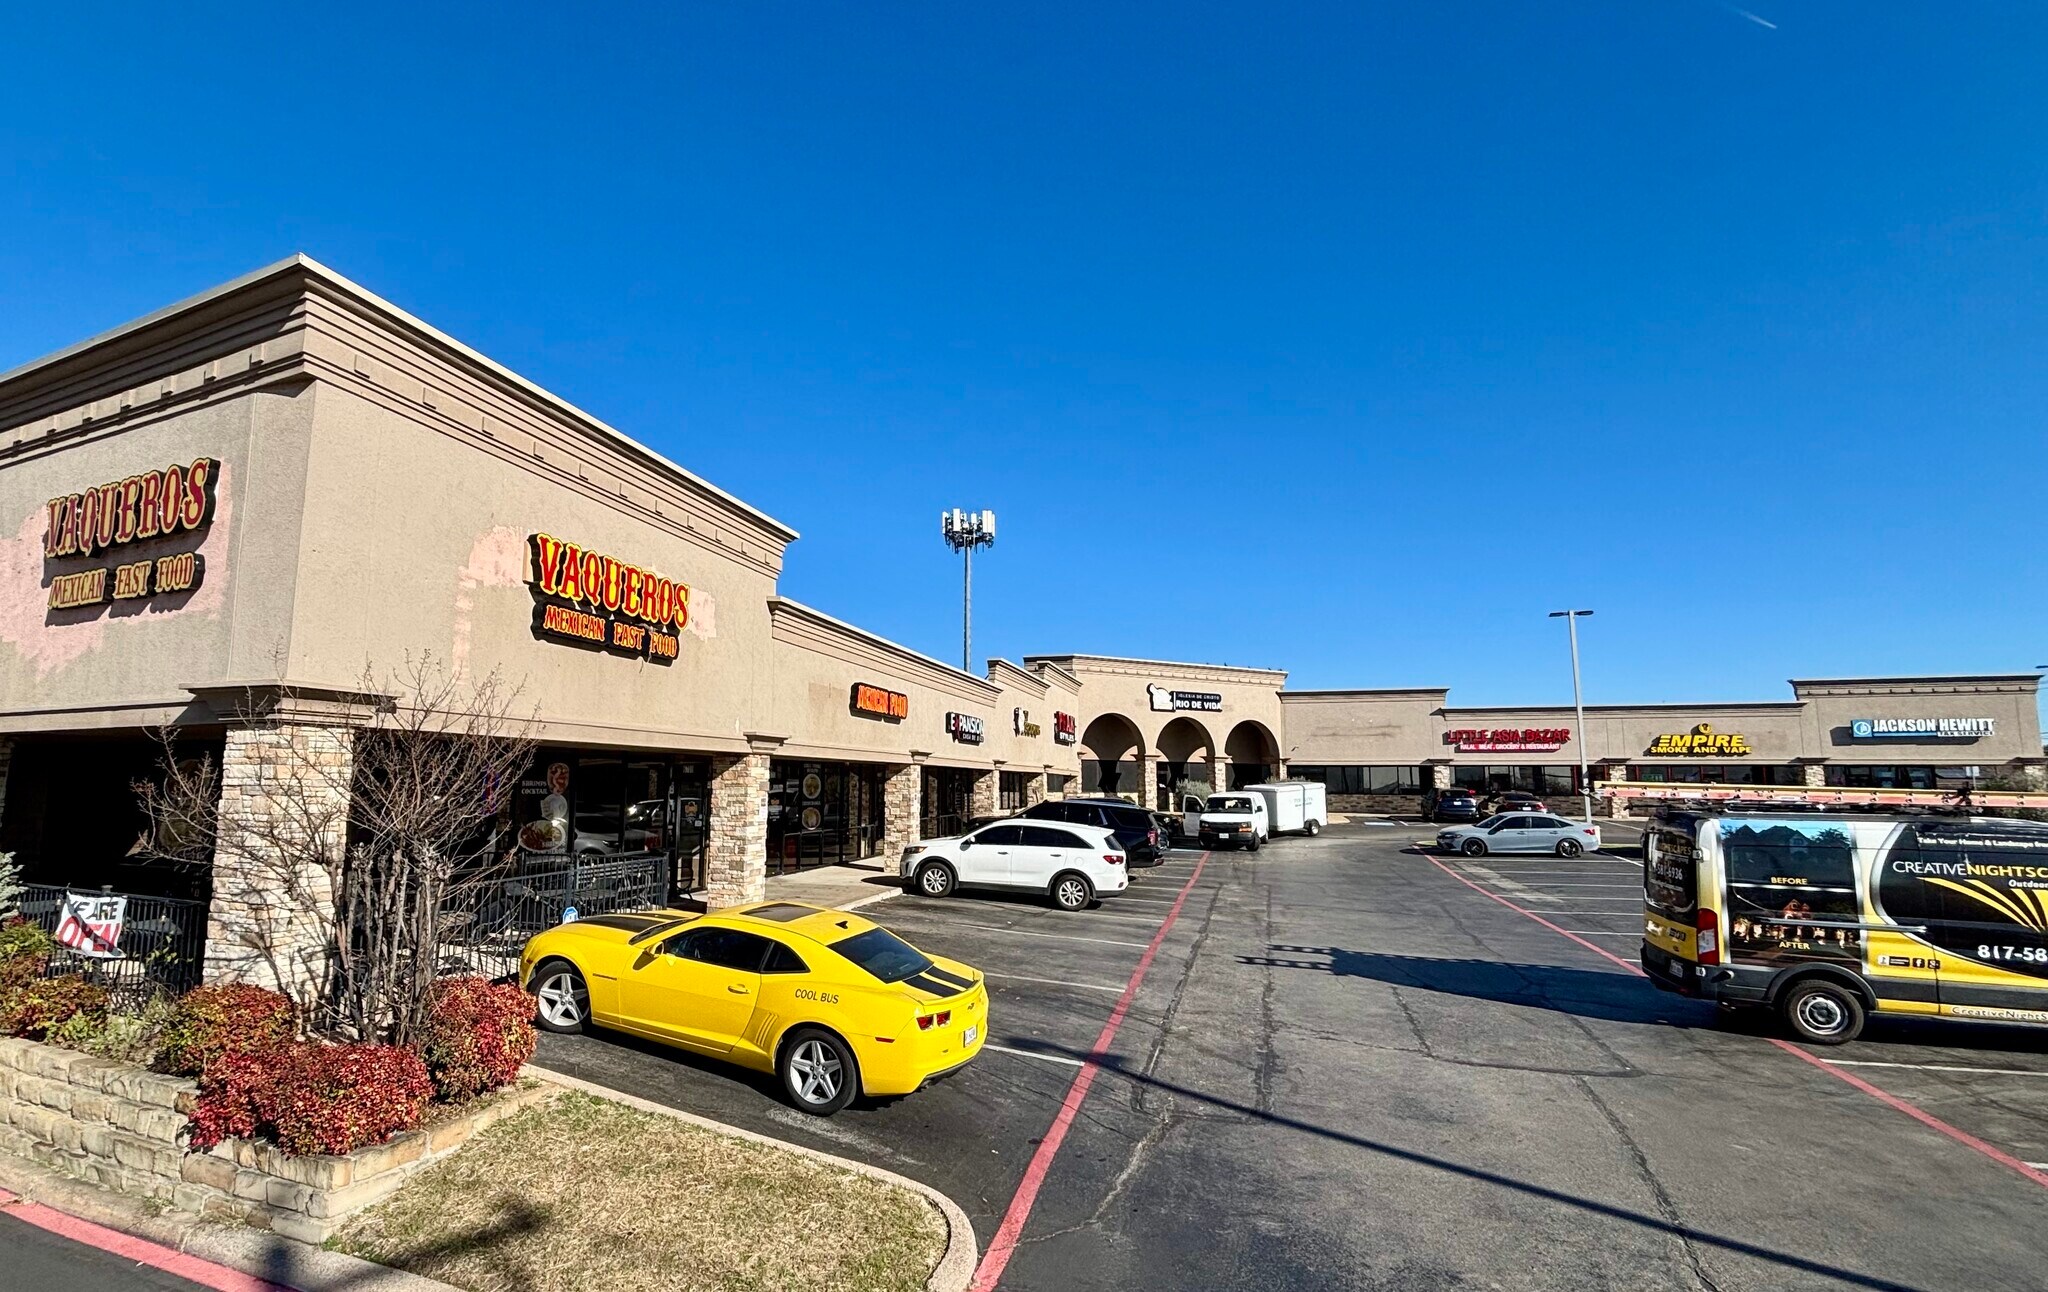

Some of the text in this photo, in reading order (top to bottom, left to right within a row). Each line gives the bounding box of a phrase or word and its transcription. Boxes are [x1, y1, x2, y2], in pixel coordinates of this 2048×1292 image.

[46, 458, 210, 557] VAQUEROS
[47, 552, 195, 609] MEXICAN FAST FOOD
[537, 533, 690, 631] VAQUEROS
[543, 605, 677, 657] MEXICAN FAST FOOD
[1176, 700, 1222, 710] RIO DE VIDA
[951, 713, 984, 735] EXPANSION
[1873, 718, 1995, 732] JACKSON HEWITT
[1448, 728, 1571, 742] LITTLE ASIA BAZAR
[1659, 734, 1744, 747] EMPIRE
[1938, 837, 1958, 845] Your
[1959, 838, 1983, 846] Home
[1770, 877, 1808, 885] BEFORE
[2008, 879, 2048, 889] Outdoor
[1779, 941, 1811, 950] AFTER
[1977, 944, 2048, 962] 817-58
[795, 988, 840, 1004] COOL BUS
